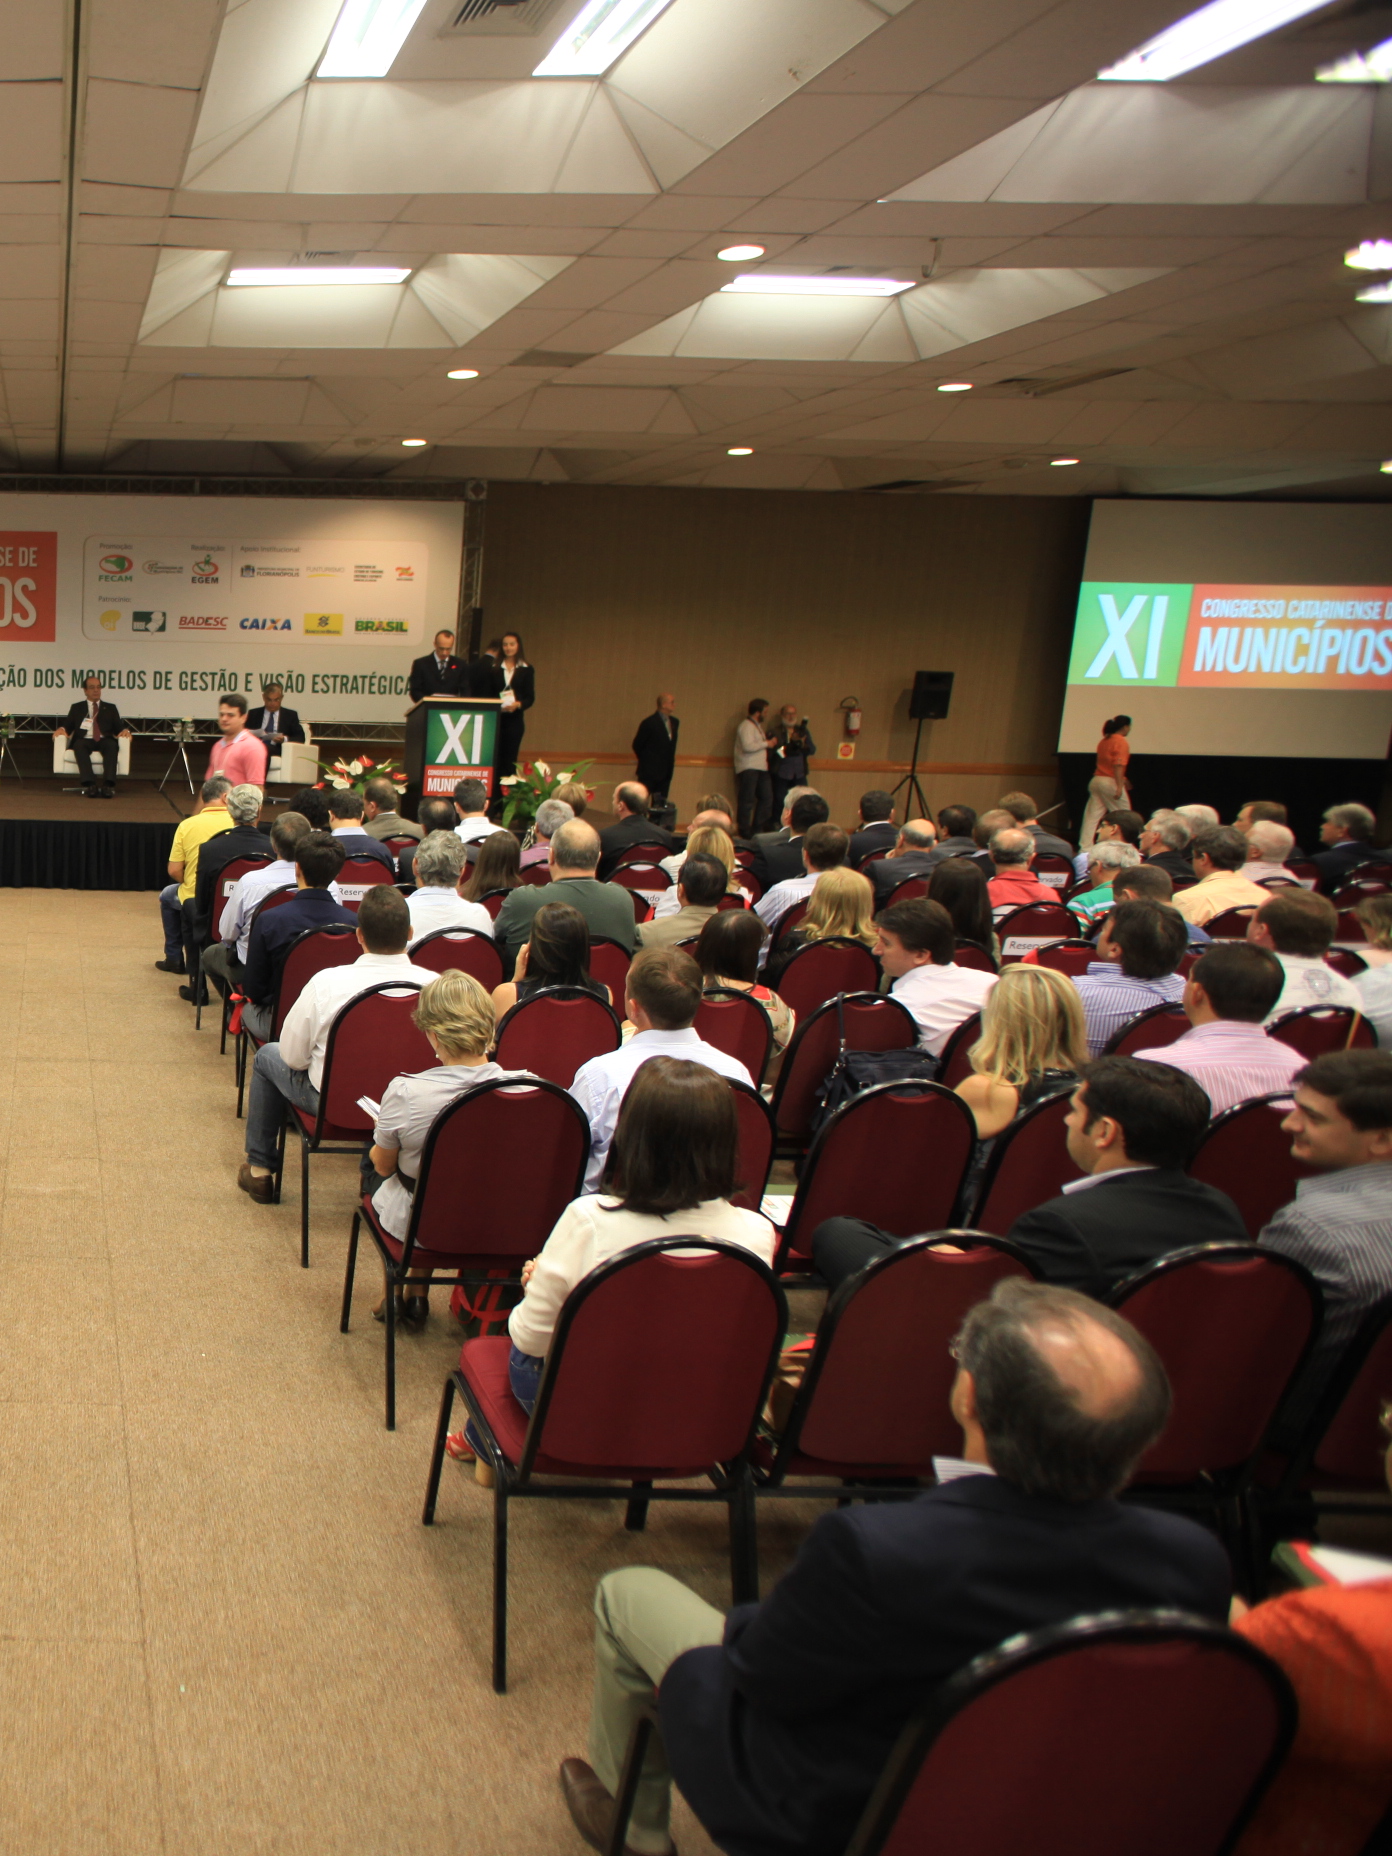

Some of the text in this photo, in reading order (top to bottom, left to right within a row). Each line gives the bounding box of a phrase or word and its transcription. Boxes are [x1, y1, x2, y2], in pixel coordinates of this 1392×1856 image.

[240, 545, 259, 553] Apoio
[18, 546, 38, 568] DE
[98, 574, 133, 582] FECAM
[191, 576, 219, 584] EGEM
[1200, 598, 1286, 619] CONGRESSO
[1287, 599, 1383, 621] CATARINENSE
[178, 616, 229, 627] BADESC
[239, 618, 292, 631] CAIXA
[355, 620, 408, 632] BRASIL
[1084, 594, 1170, 680] XI
[1193, 619, 1392, 677] MUNICÍPIOS
[33, 668, 65, 689] DOS
[153, 670, 173, 690] DE
[178, 668, 238, 692] GESTÃO
[244, 672, 254, 692] E
[434, 713, 484, 765] XI
[339, 887, 366, 896] Reserv
